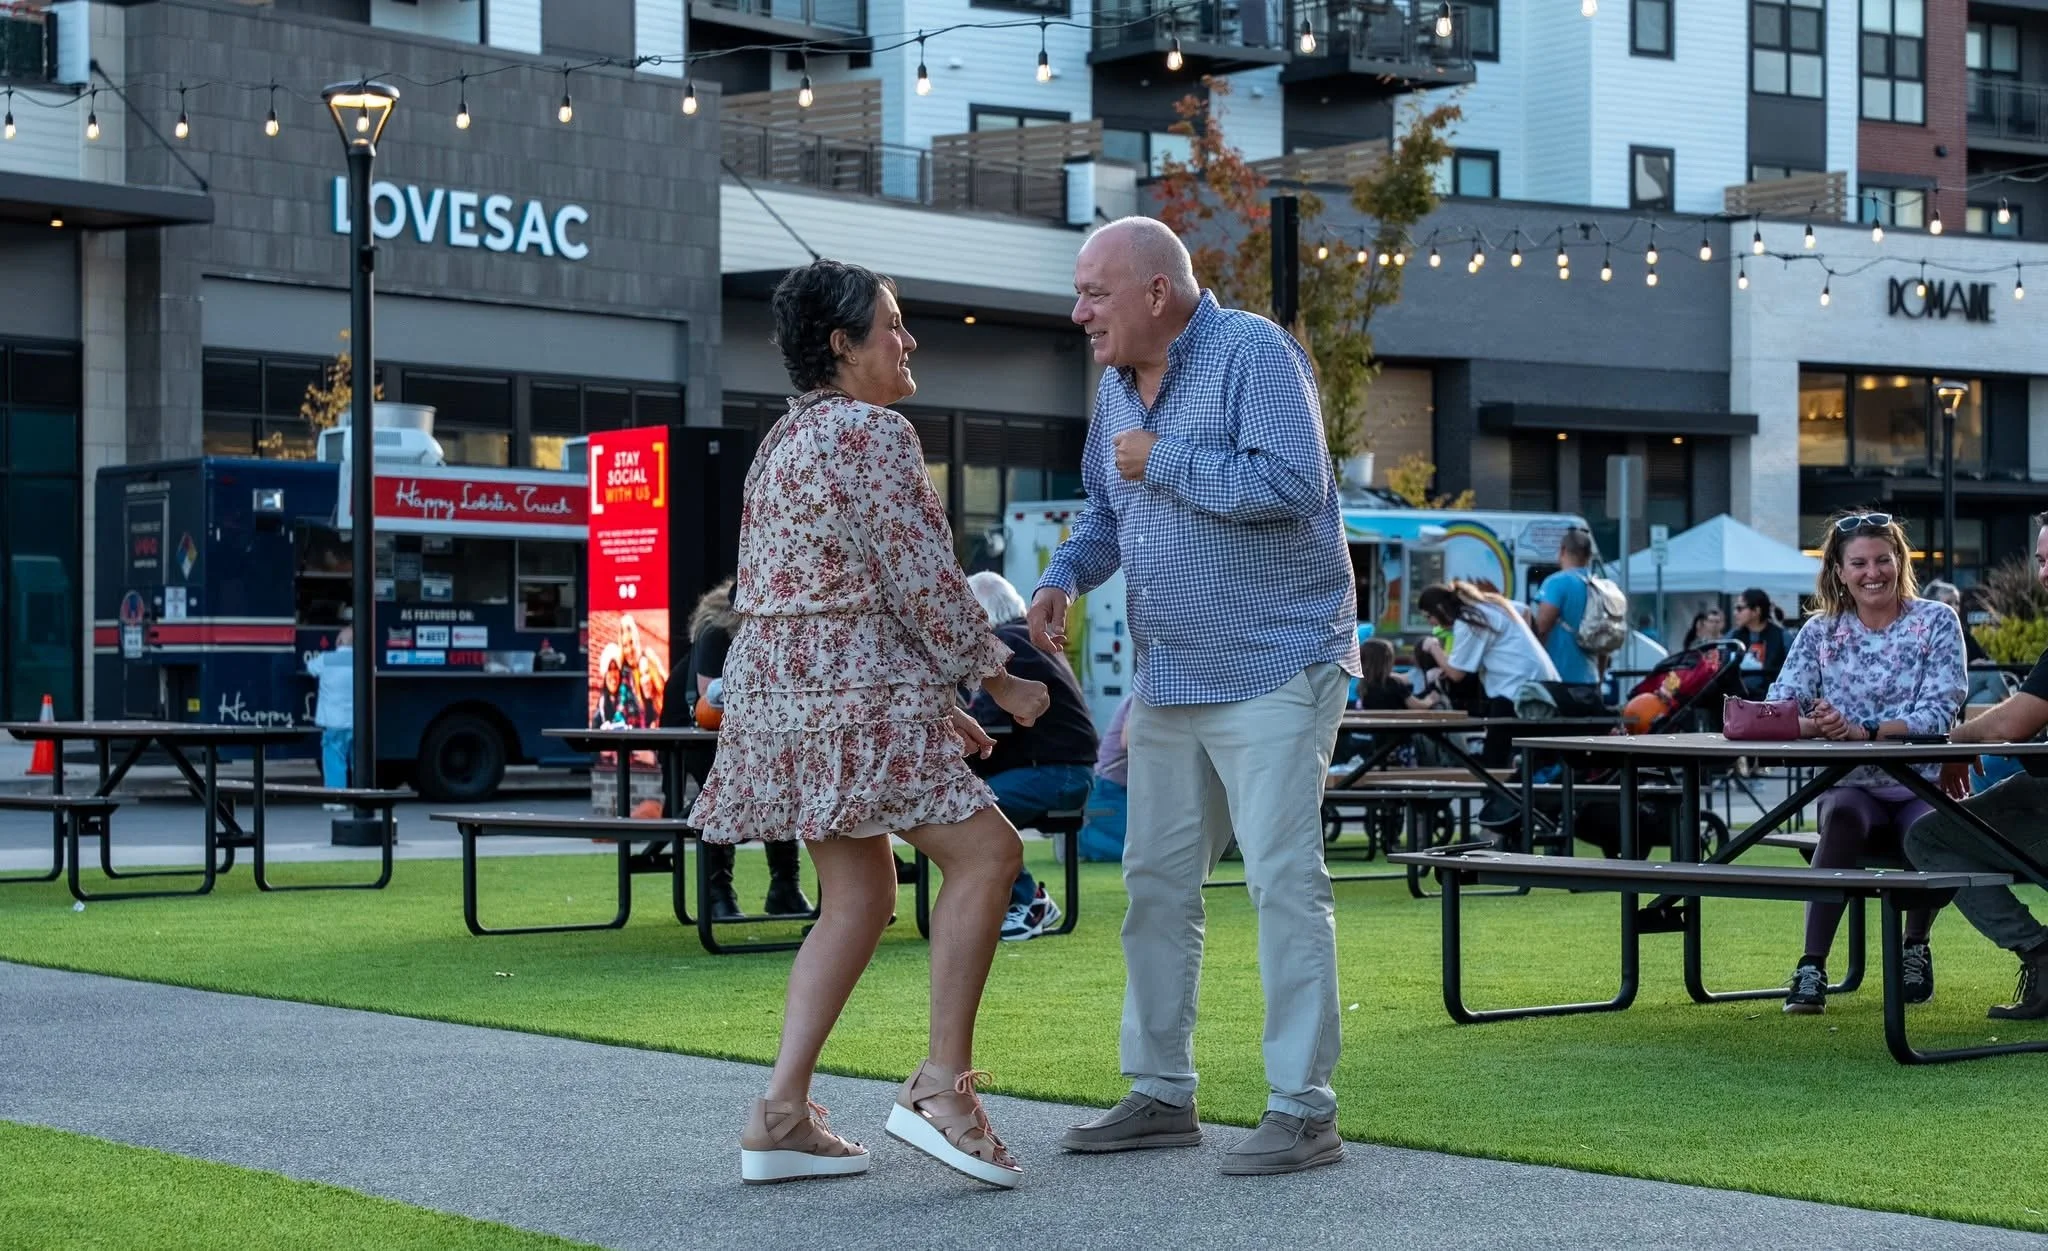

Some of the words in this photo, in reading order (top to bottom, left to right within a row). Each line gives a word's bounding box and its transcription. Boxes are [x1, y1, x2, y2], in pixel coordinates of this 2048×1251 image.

[333, 175, 590, 260] LOVESAC
[614, 450, 641, 468] STAY
[607, 466, 649, 486] SOCIAL
[396, 479, 456, 520] Happy
[460, 482, 517, 513] Lobster
[516, 485, 572, 515] Truck
[605, 486, 633, 503] WITH
[635, 484, 651, 501] US
[400, 608, 413, 621] AS
[414, 608, 458, 621] FEATURED
[218, 691, 296, 728] Happy
